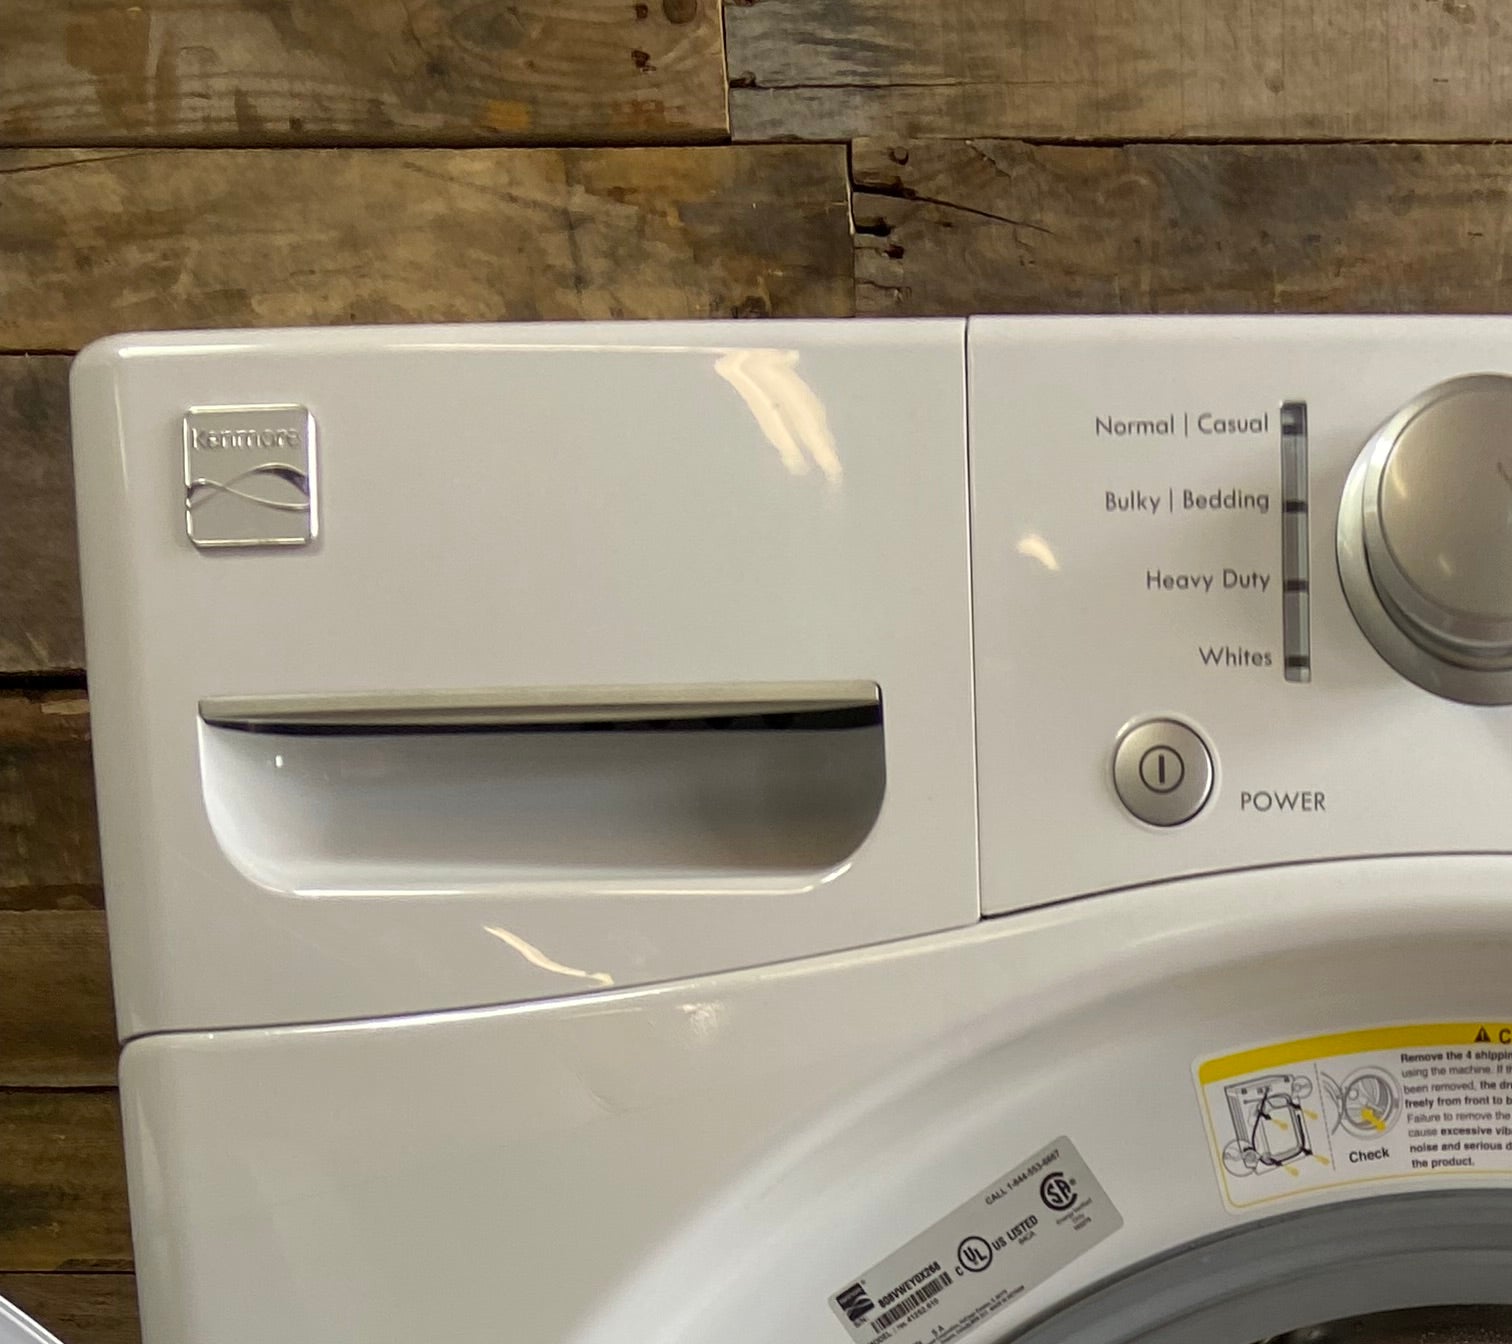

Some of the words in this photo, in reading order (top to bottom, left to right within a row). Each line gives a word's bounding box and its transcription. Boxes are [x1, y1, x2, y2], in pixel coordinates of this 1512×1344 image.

[1095, 414, 1174, 436] Normal
[1197, 412, 1269, 434] Casual
[1105, 490, 1160, 514] Bulky
[1183, 490, 1270, 513] Bedding
[1146, 569, 1214, 593] Heavy
[1223, 568, 1271, 591] Duty
[1199, 646, 1273, 667] Whites
[1240, 791, 1327, 812] POWER
[1349, 1147, 1390, 1163] Check
[1007, 1215, 1038, 1241] LISTED
